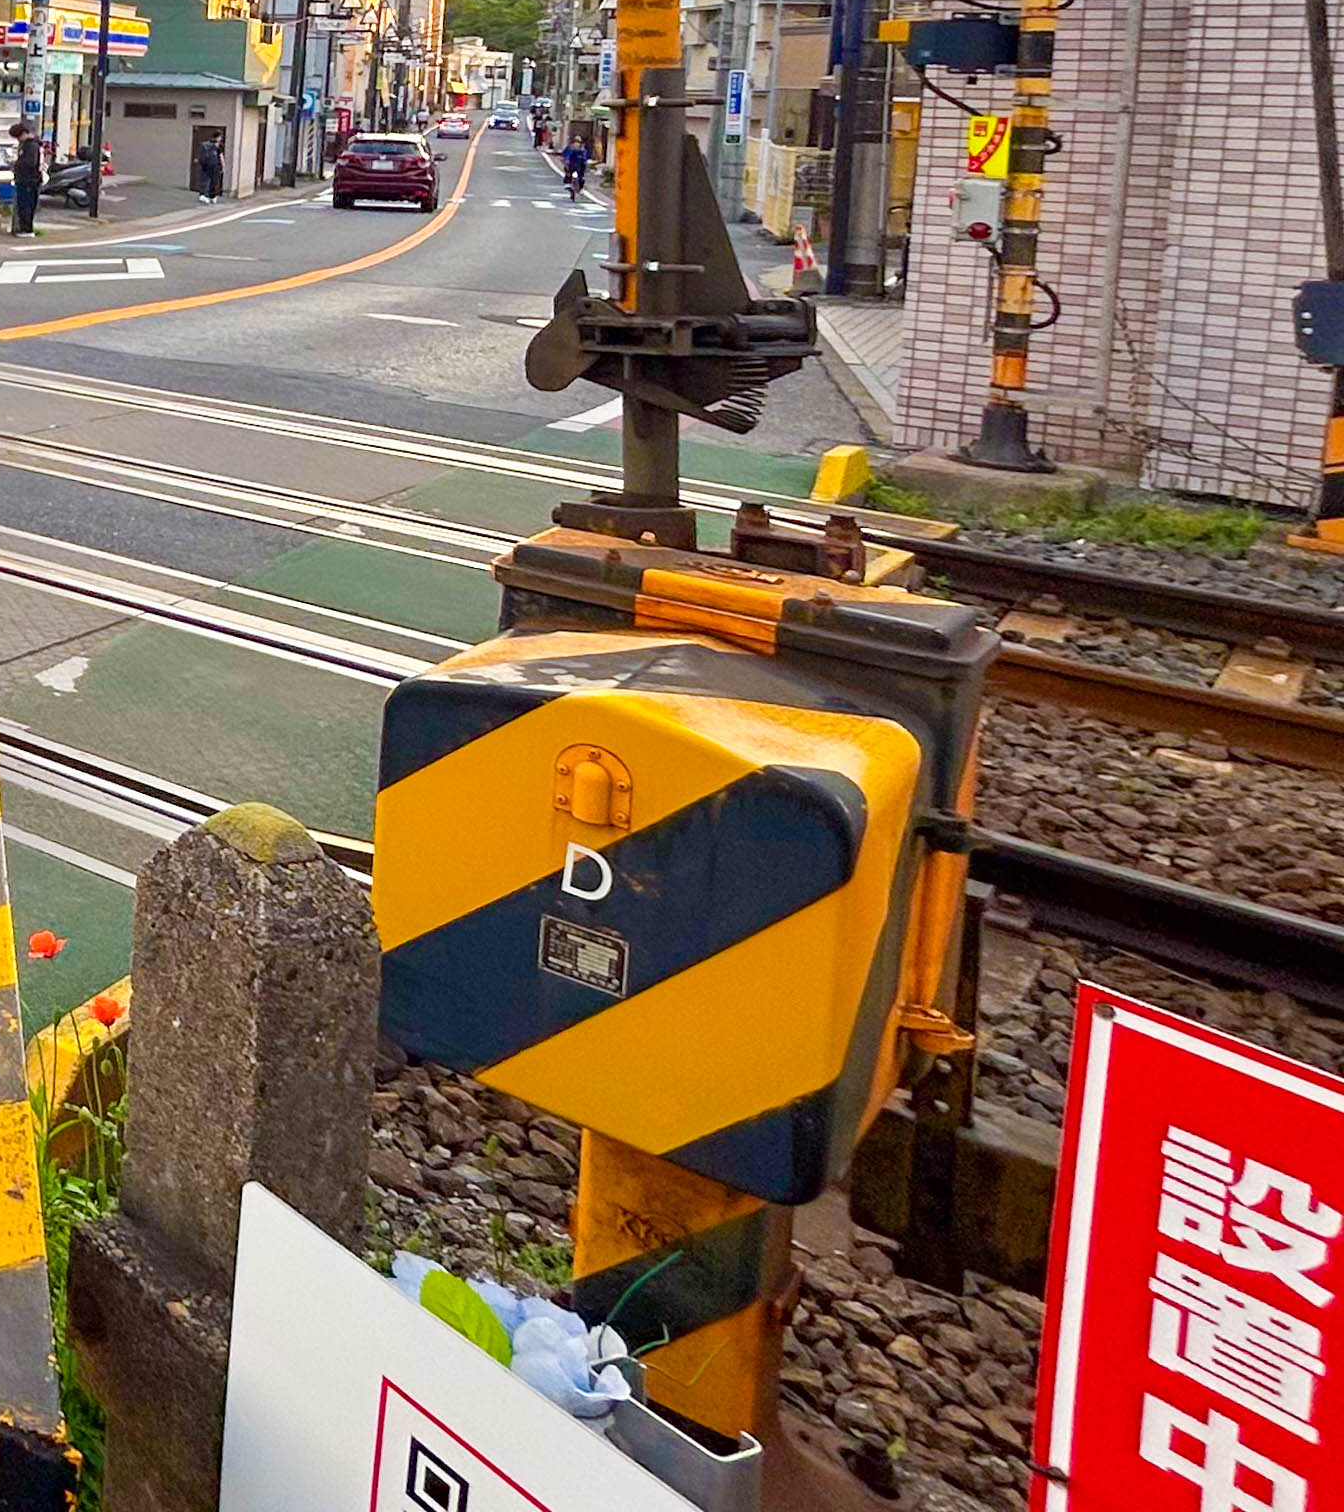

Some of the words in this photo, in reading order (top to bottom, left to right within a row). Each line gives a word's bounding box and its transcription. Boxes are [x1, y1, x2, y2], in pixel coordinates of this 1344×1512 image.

[561, 841, 613, 901] D
[1138, 1124, 1344, 1512] 設置中
